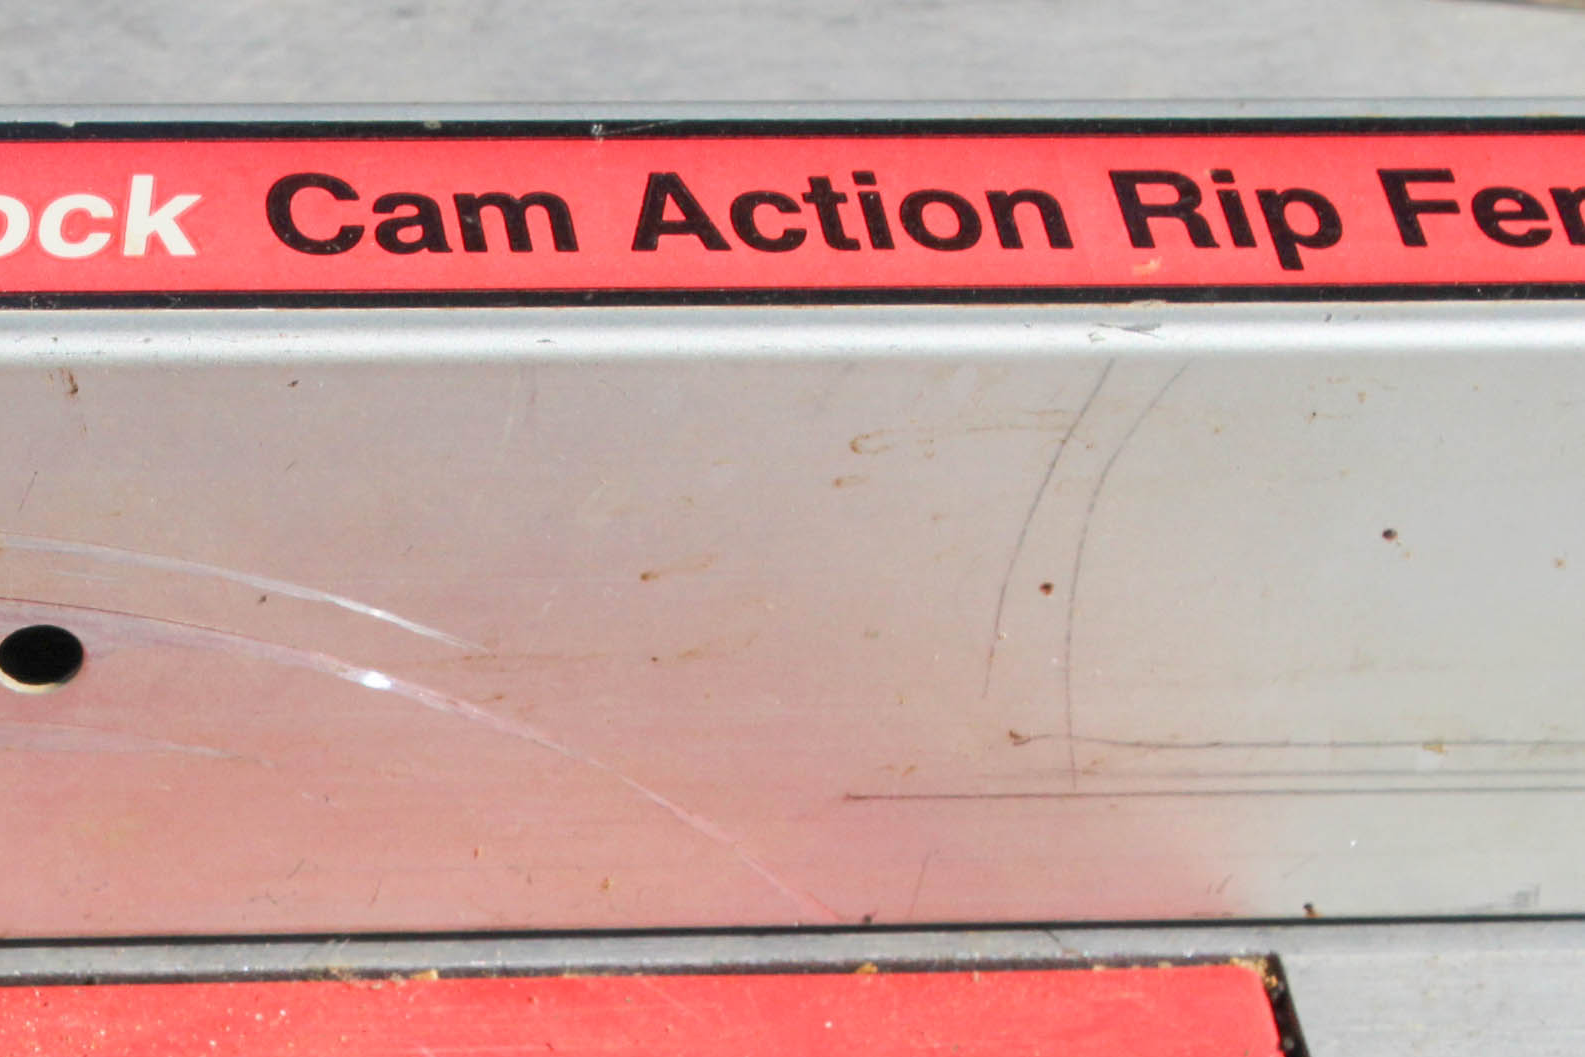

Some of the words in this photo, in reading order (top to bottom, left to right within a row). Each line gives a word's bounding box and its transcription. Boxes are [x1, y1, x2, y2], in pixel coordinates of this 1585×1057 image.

[266, 171, 579, 256] Cam
[632, 169, 1074, 252] Action
[1108, 168, 1344, 271] Rip
